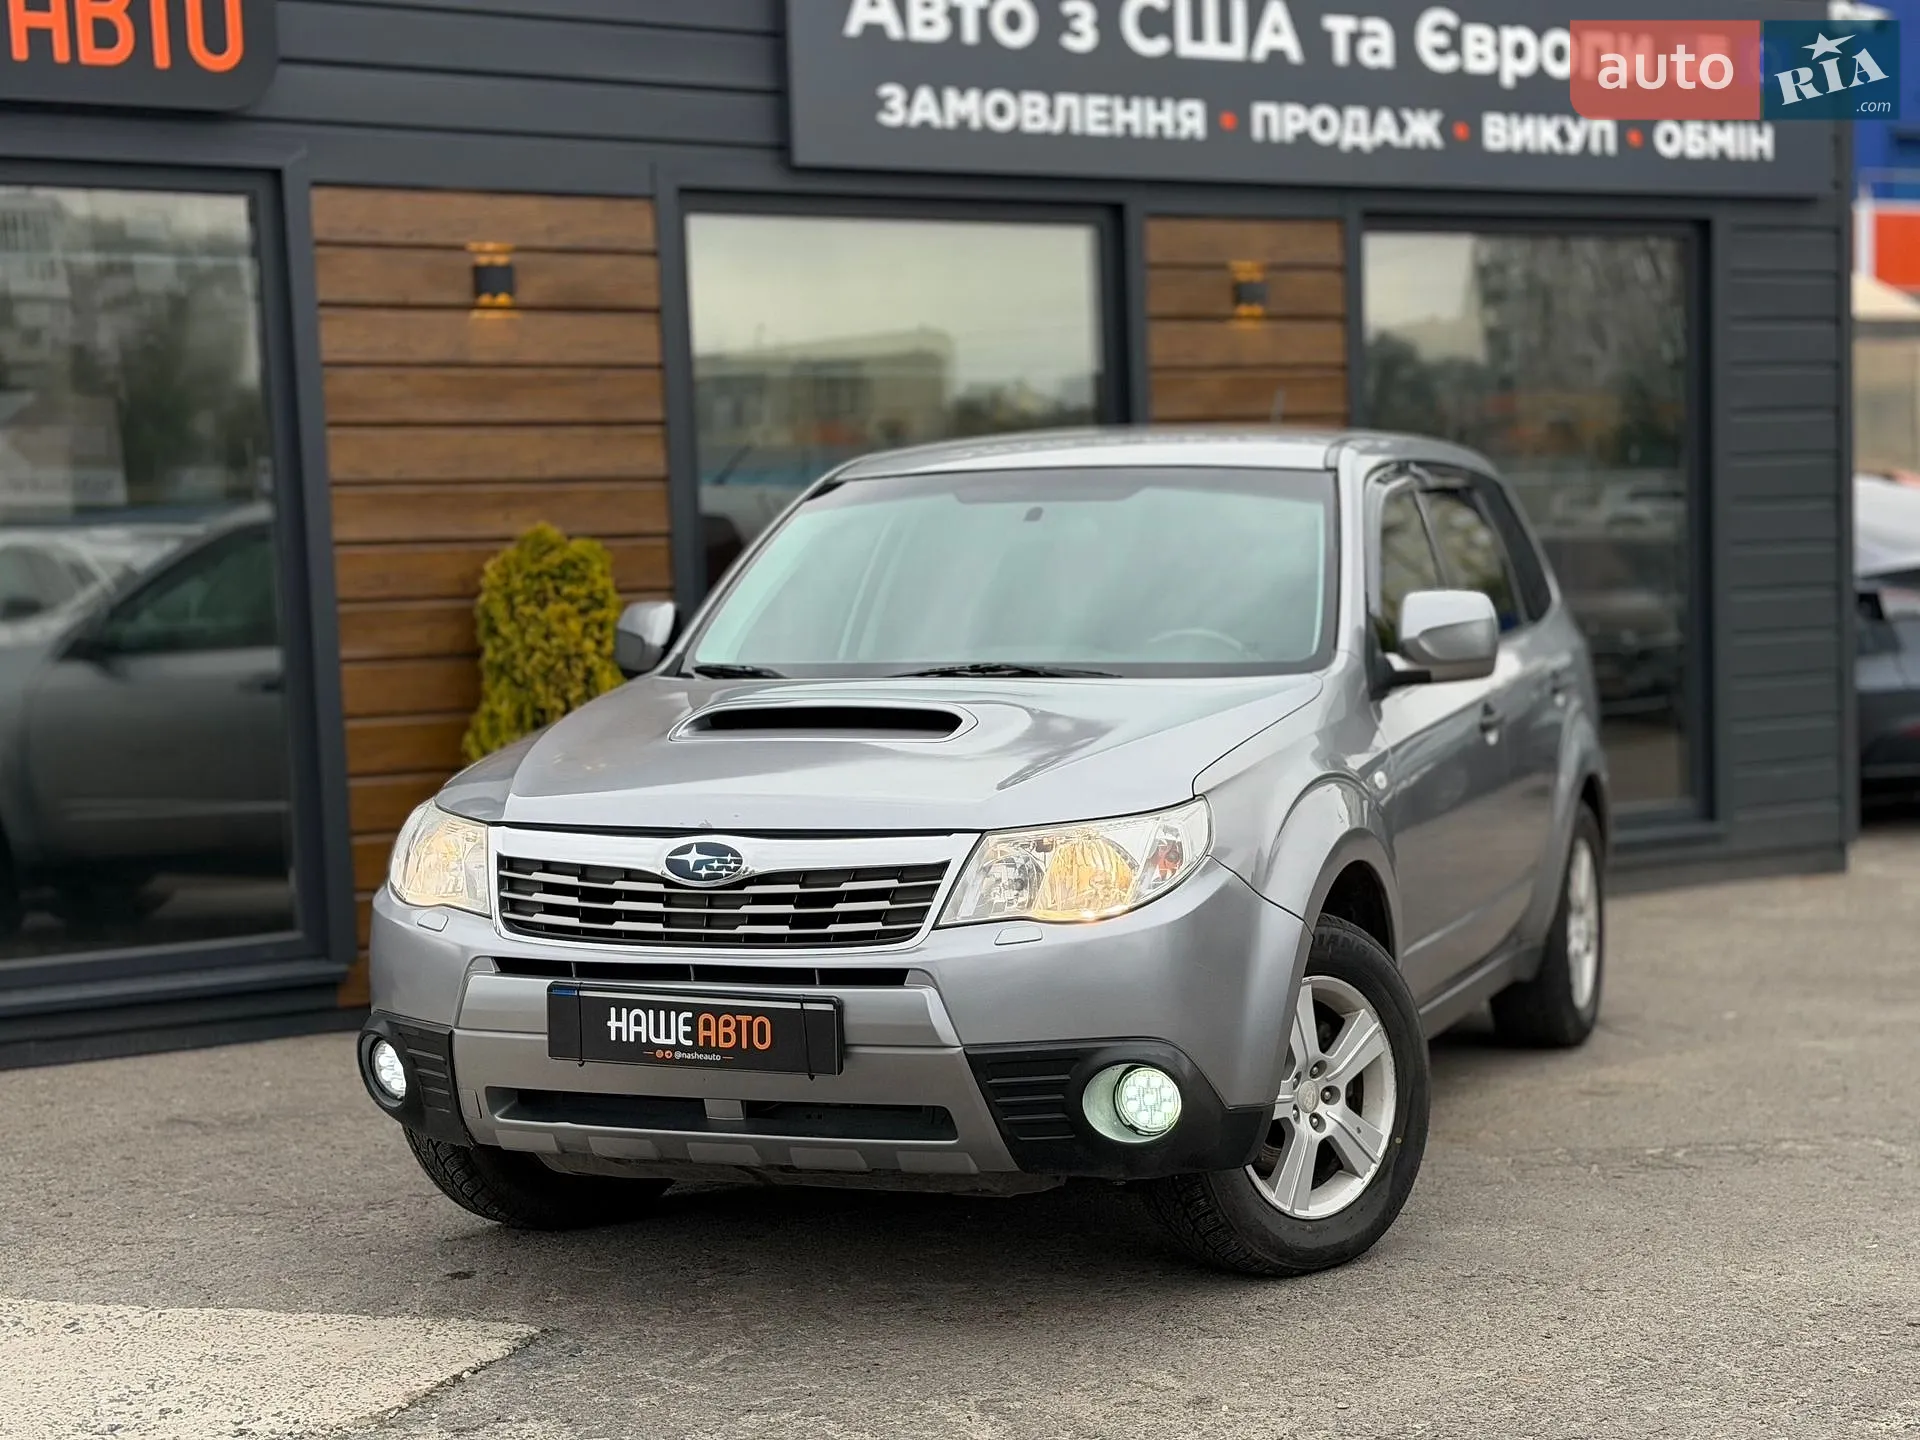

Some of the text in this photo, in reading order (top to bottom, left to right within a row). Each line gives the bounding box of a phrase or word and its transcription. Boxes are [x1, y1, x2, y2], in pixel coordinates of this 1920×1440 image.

[843, 0, 1039, 49] Авто
[1119, 0, 1304, 64] США
[1321, 13, 1396, 69] та
[876, 82, 1775, 161] ЗАМОВЛЕННЯ ПРОДАЖ ВИКУП ОБМІН
[606, 1006, 772, 1051] НАШЕ АВТО
[674, 1050, 722, 1061] @nasheauto
